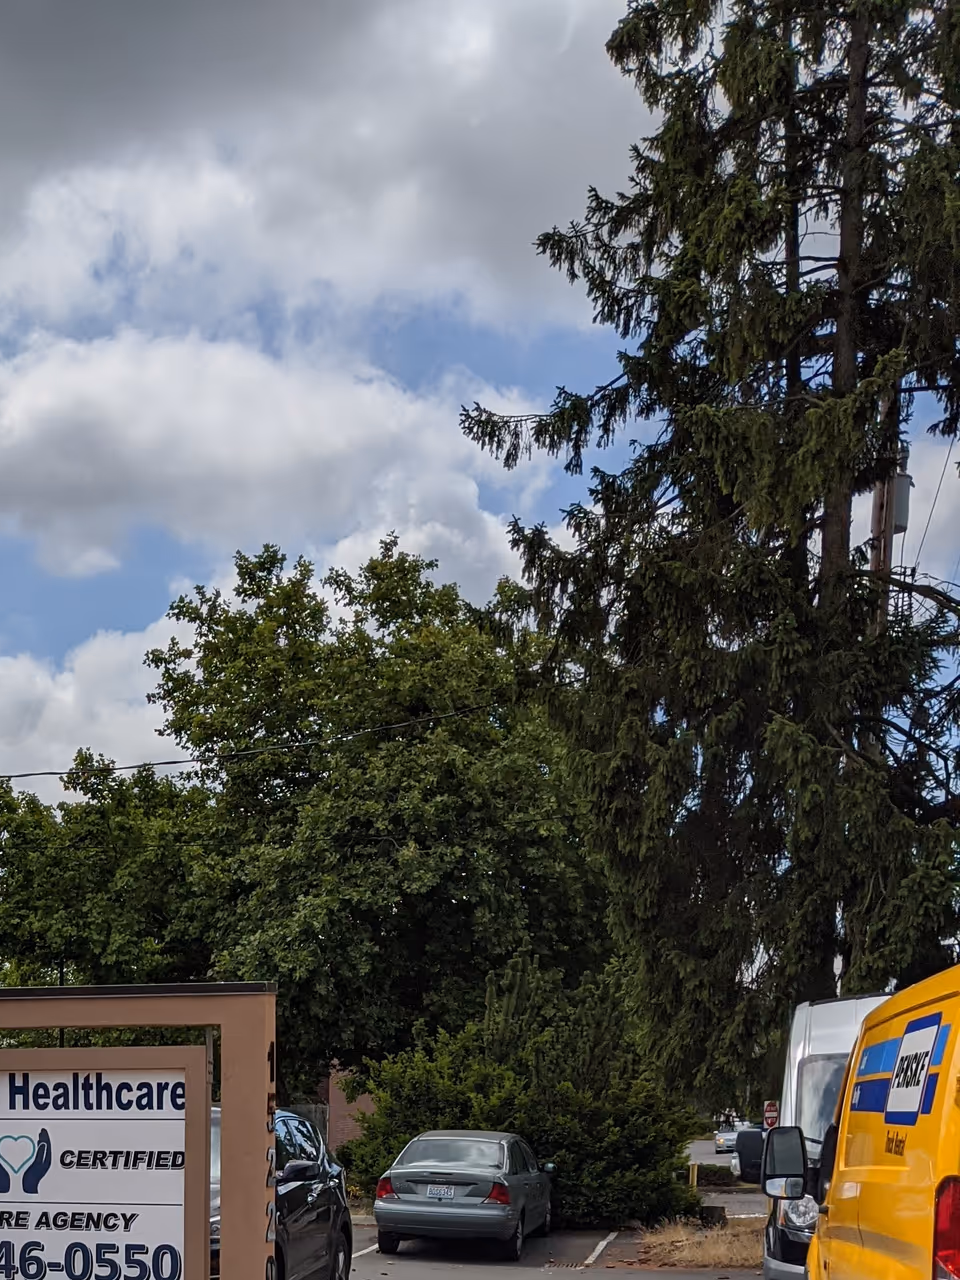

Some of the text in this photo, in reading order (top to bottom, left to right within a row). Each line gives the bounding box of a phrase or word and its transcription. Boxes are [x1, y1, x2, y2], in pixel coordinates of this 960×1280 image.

[892, 1051, 930, 1089] PENSKE
[8, 1072, 186, 1111] Healthcare
[60, 1150, 186, 1170] CERTIFIED
[34, 1211, 139, 1232] AGENCY
